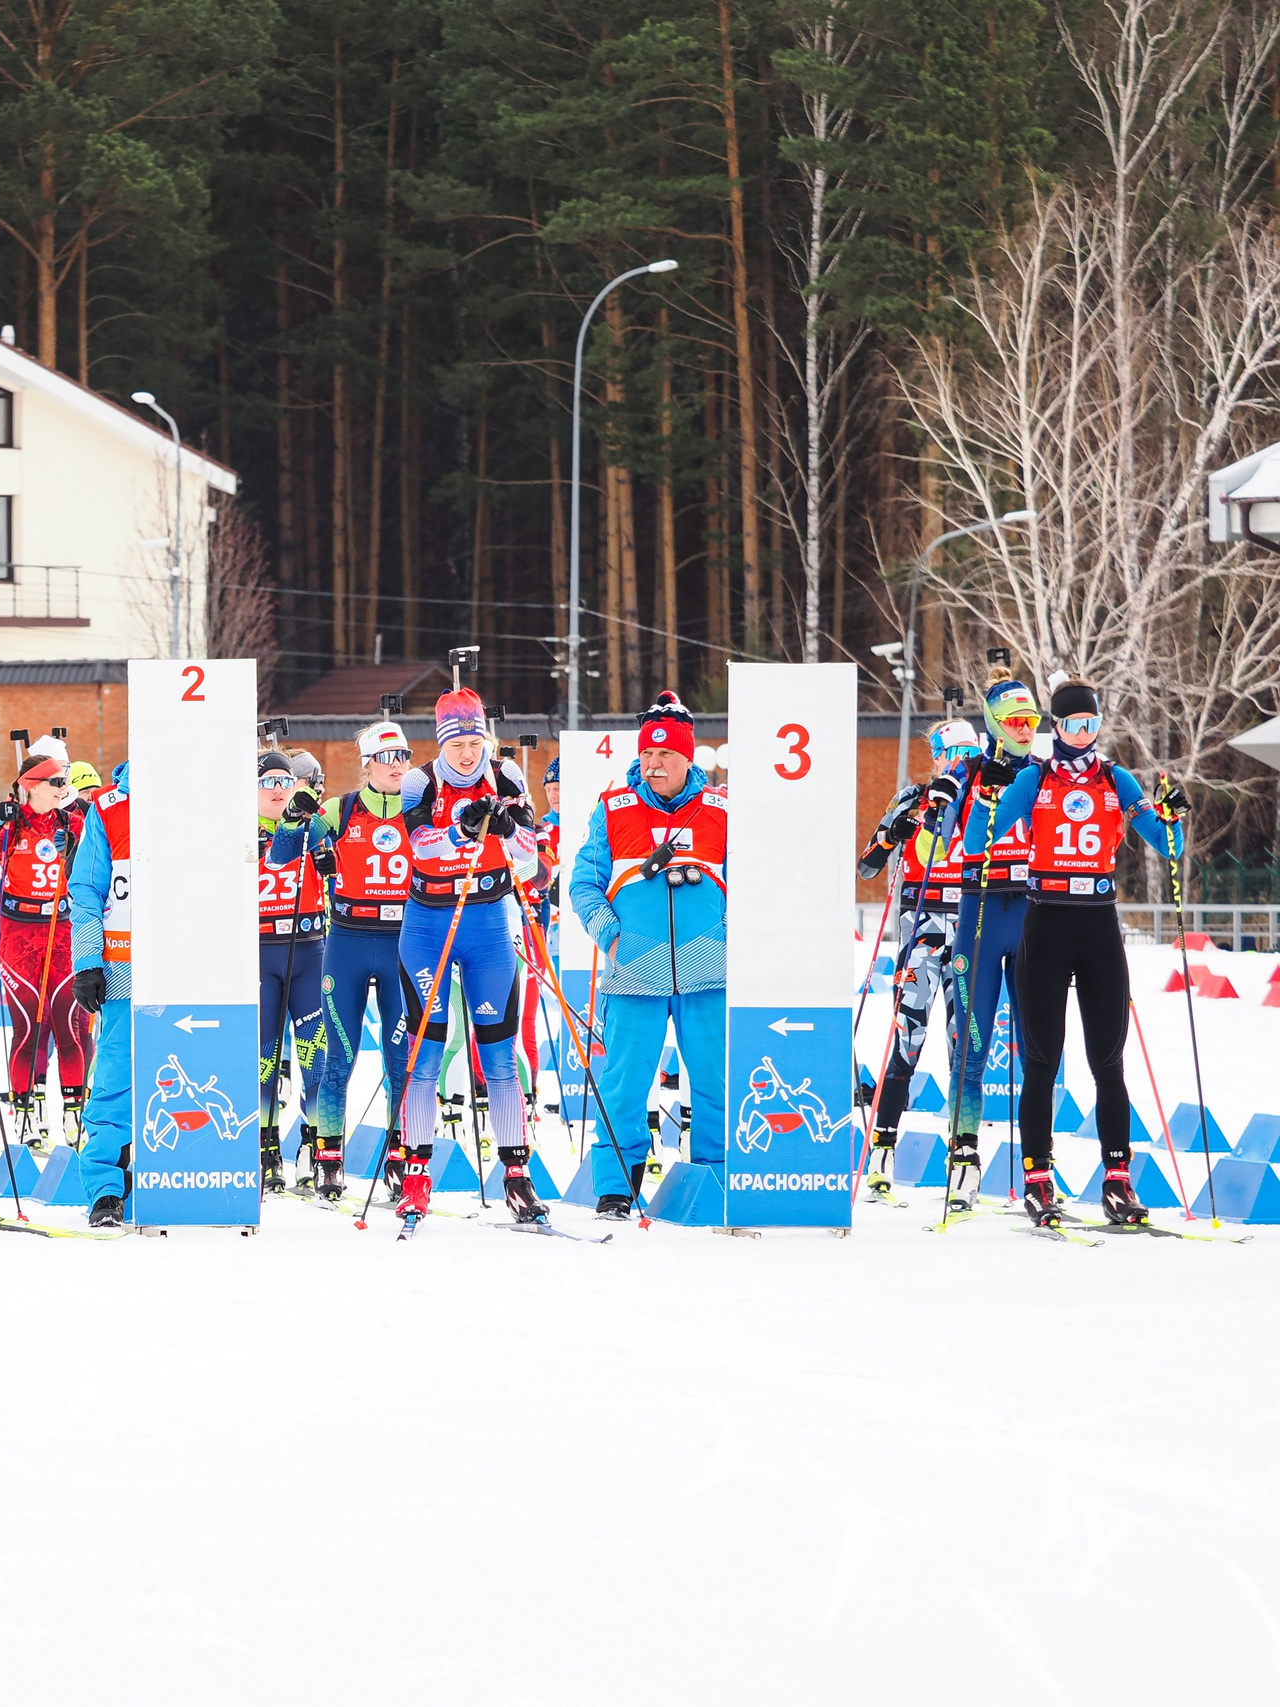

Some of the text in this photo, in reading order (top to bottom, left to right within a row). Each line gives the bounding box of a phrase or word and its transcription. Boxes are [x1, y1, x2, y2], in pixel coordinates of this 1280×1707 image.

[181, 665, 206, 702] 2
[595, 735, 613, 759] 4
[773, 723, 812, 781] 3
[108, 793, 116, 803] 8
[613, 795, 631, 808] 35
[708, 795, 724, 808] 35
[1053, 823, 1101, 857] 16
[364, 855, 409, 885] 19
[439, 862, 483, 873] КРАСНОЯСК
[1053, 860, 1099, 868] КРАСНОЯРСК
[31, 863, 61, 889] 39
[258, 871, 298, 901] 23
[259, 903, 296, 913] КРАСНОЯРС
[105, 937, 131, 950] Крас
[137, 1171, 257, 1189] КРАСНОЯРСК
[729, 1173, 849, 1191] КРАСНОЯРСК
